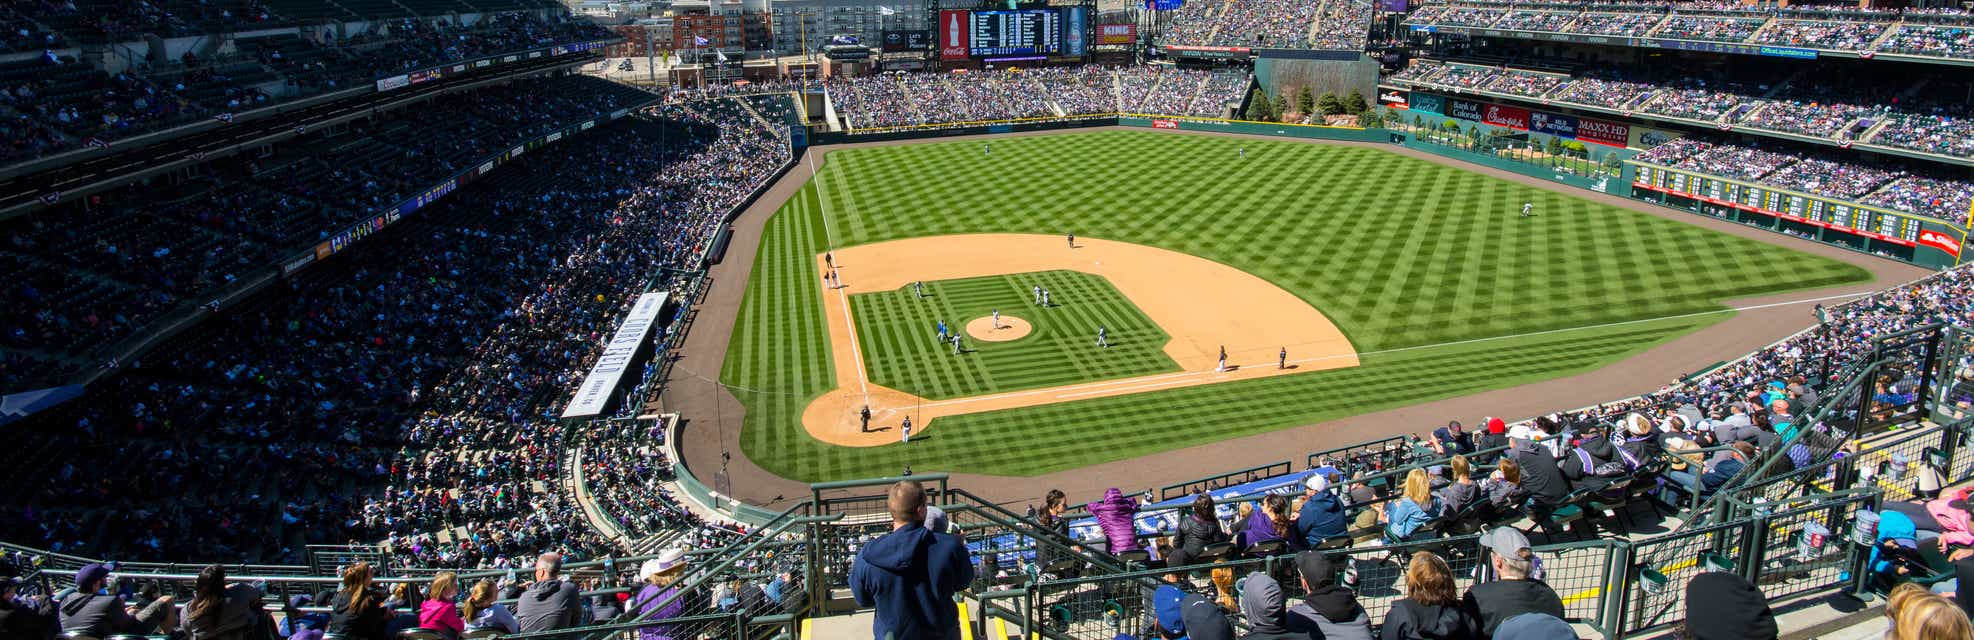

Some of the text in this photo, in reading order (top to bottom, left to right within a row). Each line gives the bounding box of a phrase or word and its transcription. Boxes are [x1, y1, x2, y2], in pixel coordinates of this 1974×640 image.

[1104, 25, 1129, 35] KING
[1453, 101, 1478, 111] Bank of
[1452, 110, 1482, 120] Colorado
[1546, 123, 1574, 132] NETWORK
[1579, 120, 1628, 136] MAXX HD
[1640, 131, 1668, 146] Coo
[613, 318, 649, 344] COORS
[597, 346, 633, 374] FIELD
